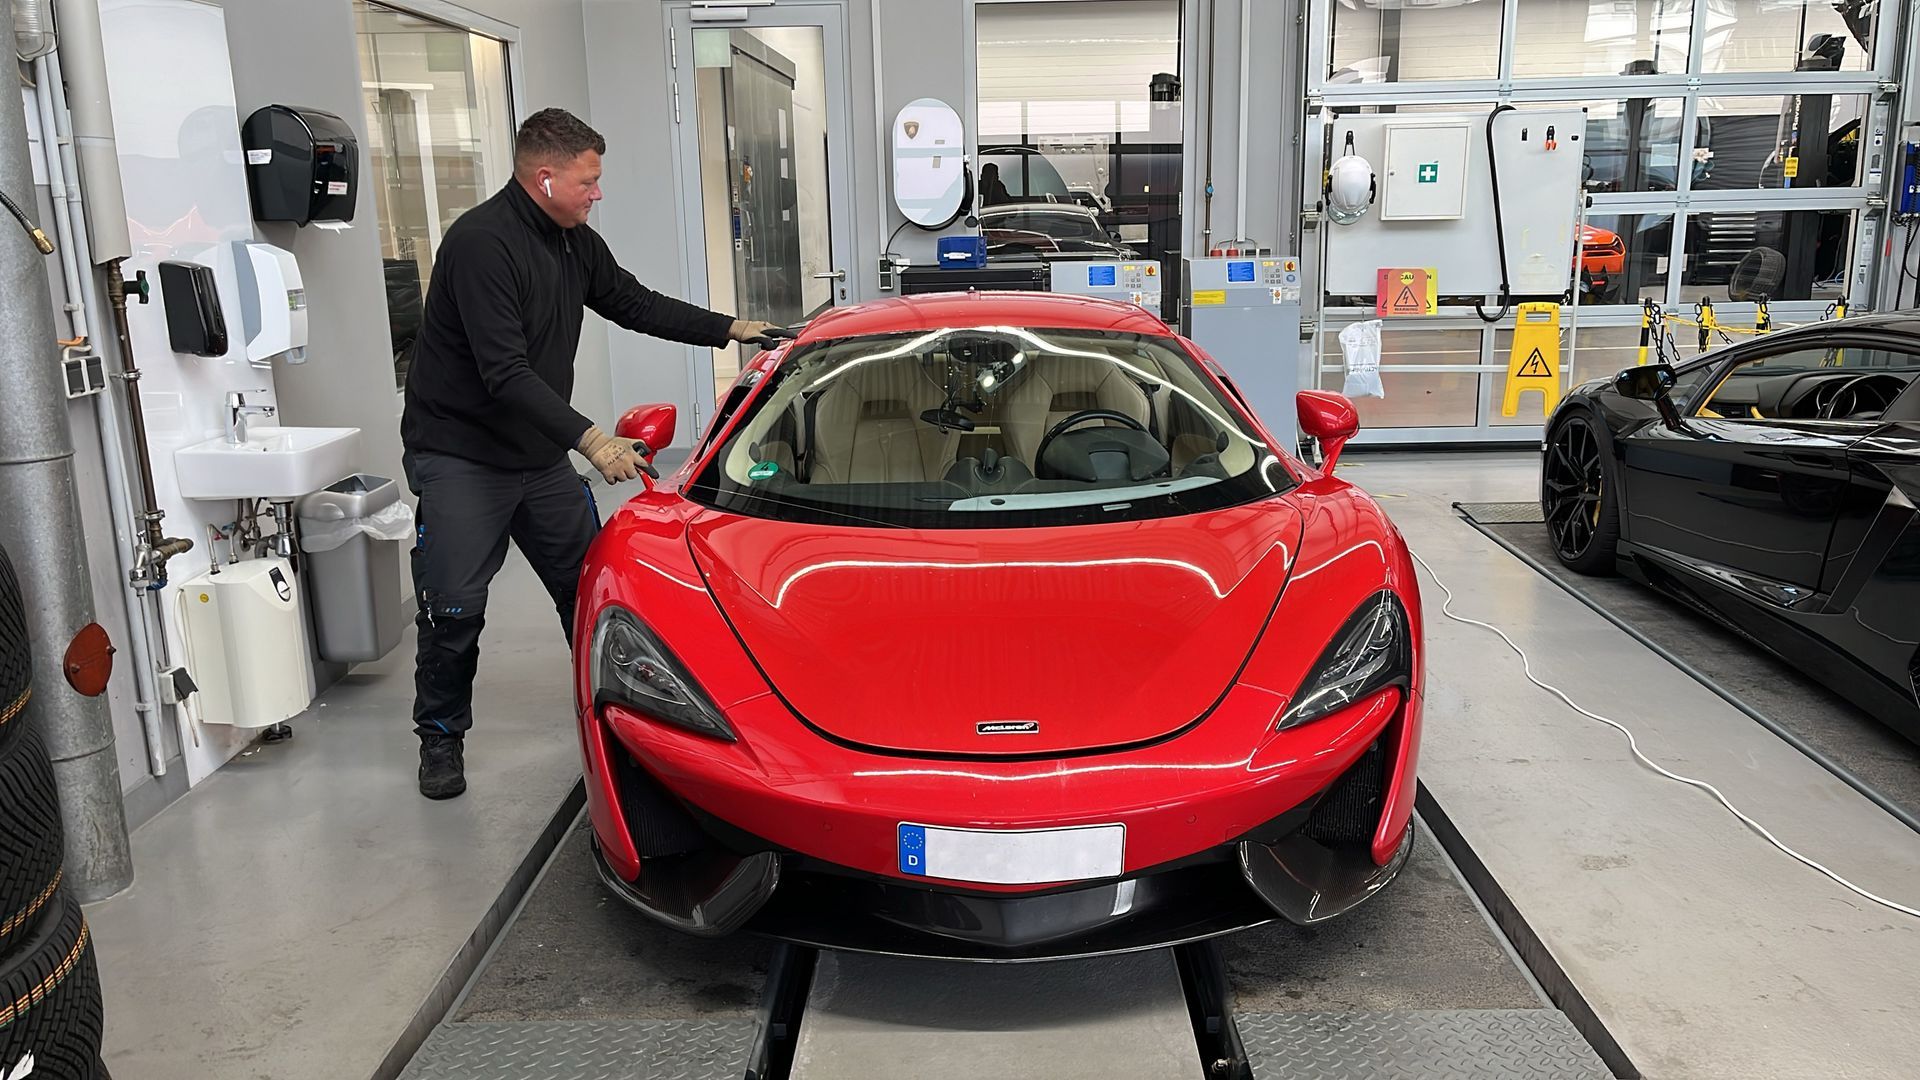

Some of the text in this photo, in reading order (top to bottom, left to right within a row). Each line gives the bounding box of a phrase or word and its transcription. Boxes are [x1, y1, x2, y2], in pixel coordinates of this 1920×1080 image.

[760, 462, 769, 471] 4
[982, 723, 1033, 731] McLaren
[909, 855, 918, 866] D
